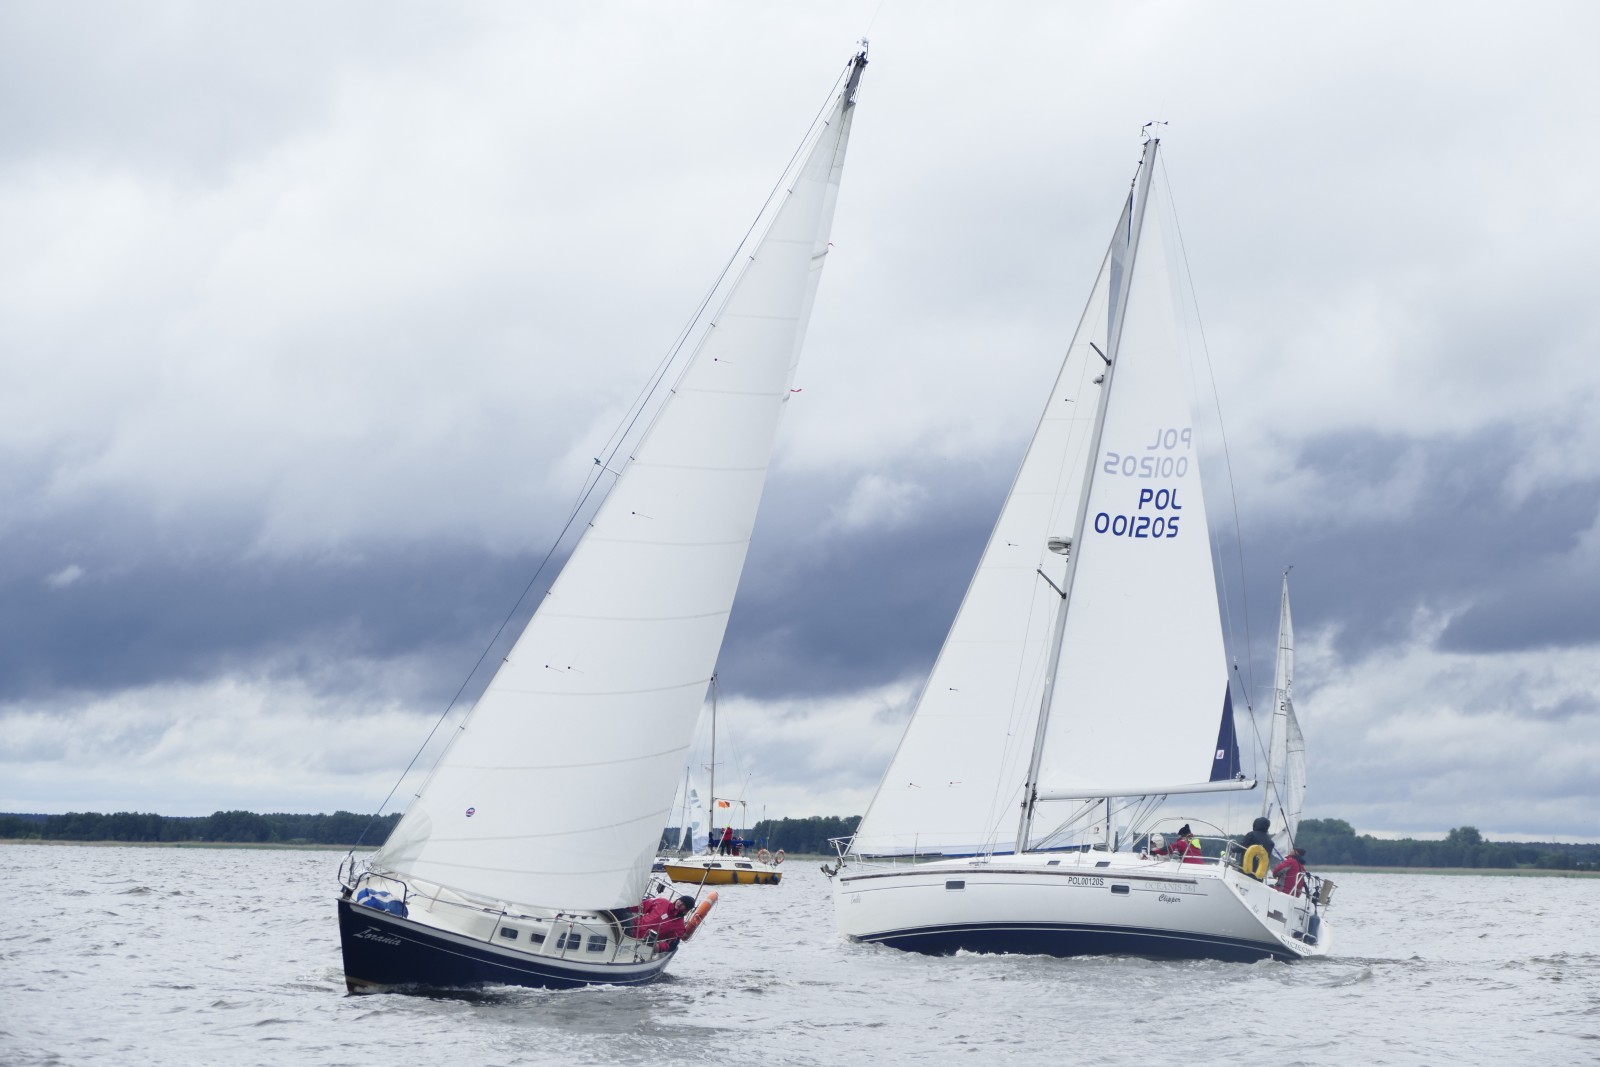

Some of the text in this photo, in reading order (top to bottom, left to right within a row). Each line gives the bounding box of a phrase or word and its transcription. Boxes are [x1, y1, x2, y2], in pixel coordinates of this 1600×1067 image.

[1138, 488, 1182, 510] POL
[1068, 876, 1104, 886] POL00120S
[1144, 881, 1182, 892] OCEANIS
[1158, 893, 1181, 904] Clipper
